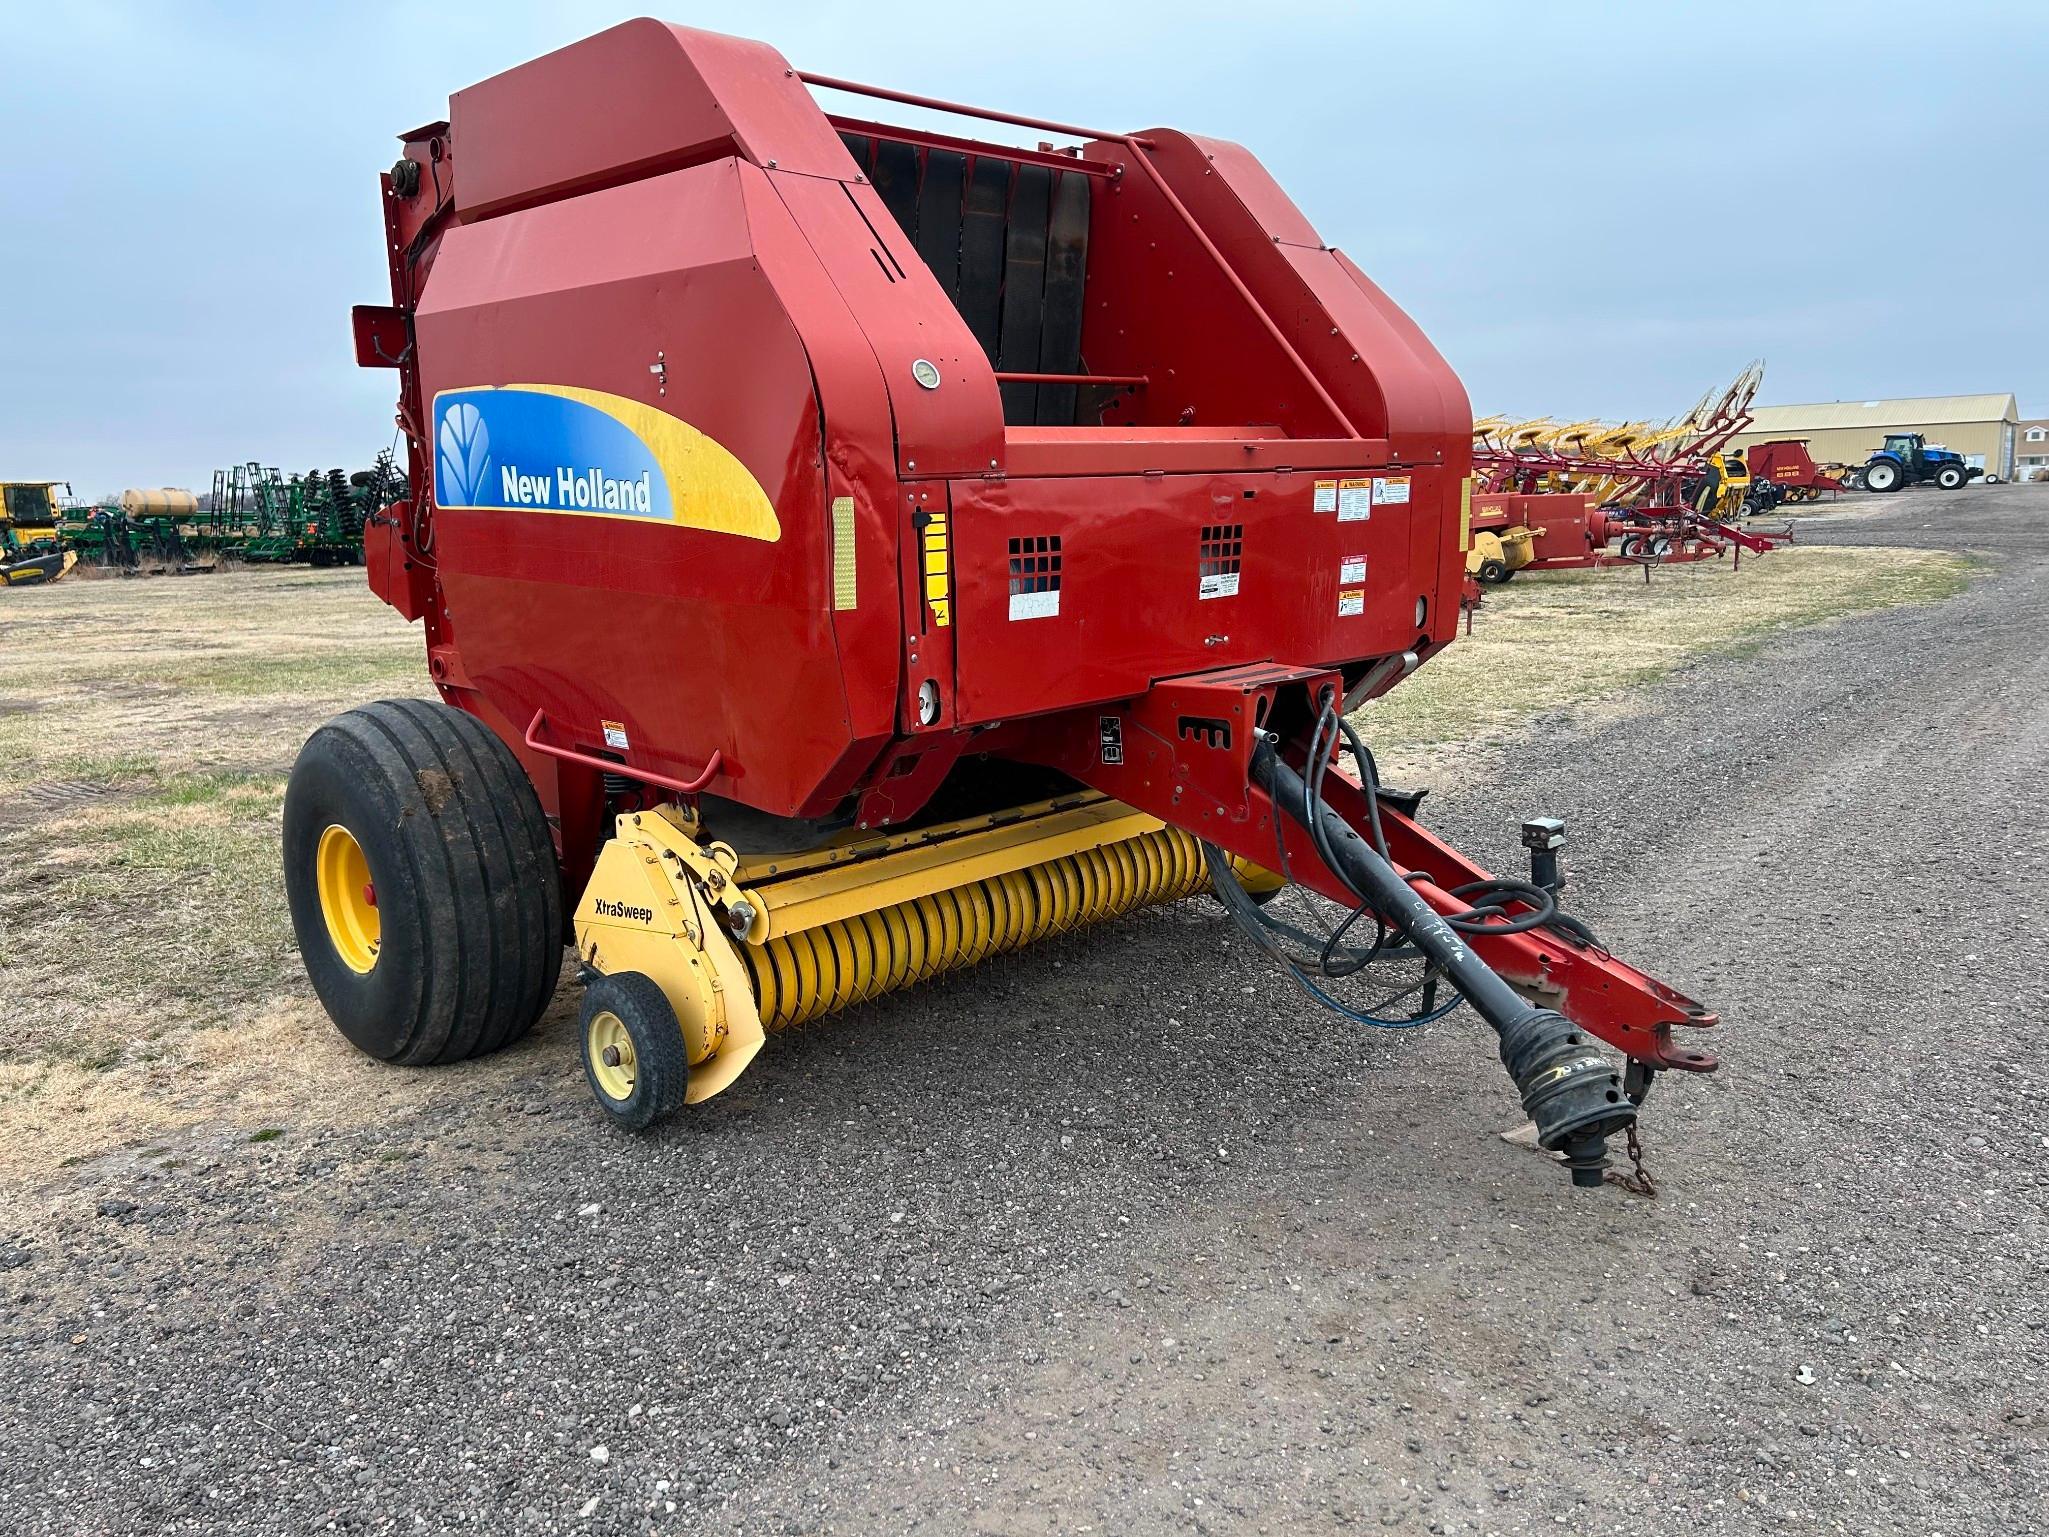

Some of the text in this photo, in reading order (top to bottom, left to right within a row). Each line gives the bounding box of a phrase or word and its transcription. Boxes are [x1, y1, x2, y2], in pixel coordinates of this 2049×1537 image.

[501, 465, 651, 512] New Holland
[595, 898, 652, 925] XtraSweep
